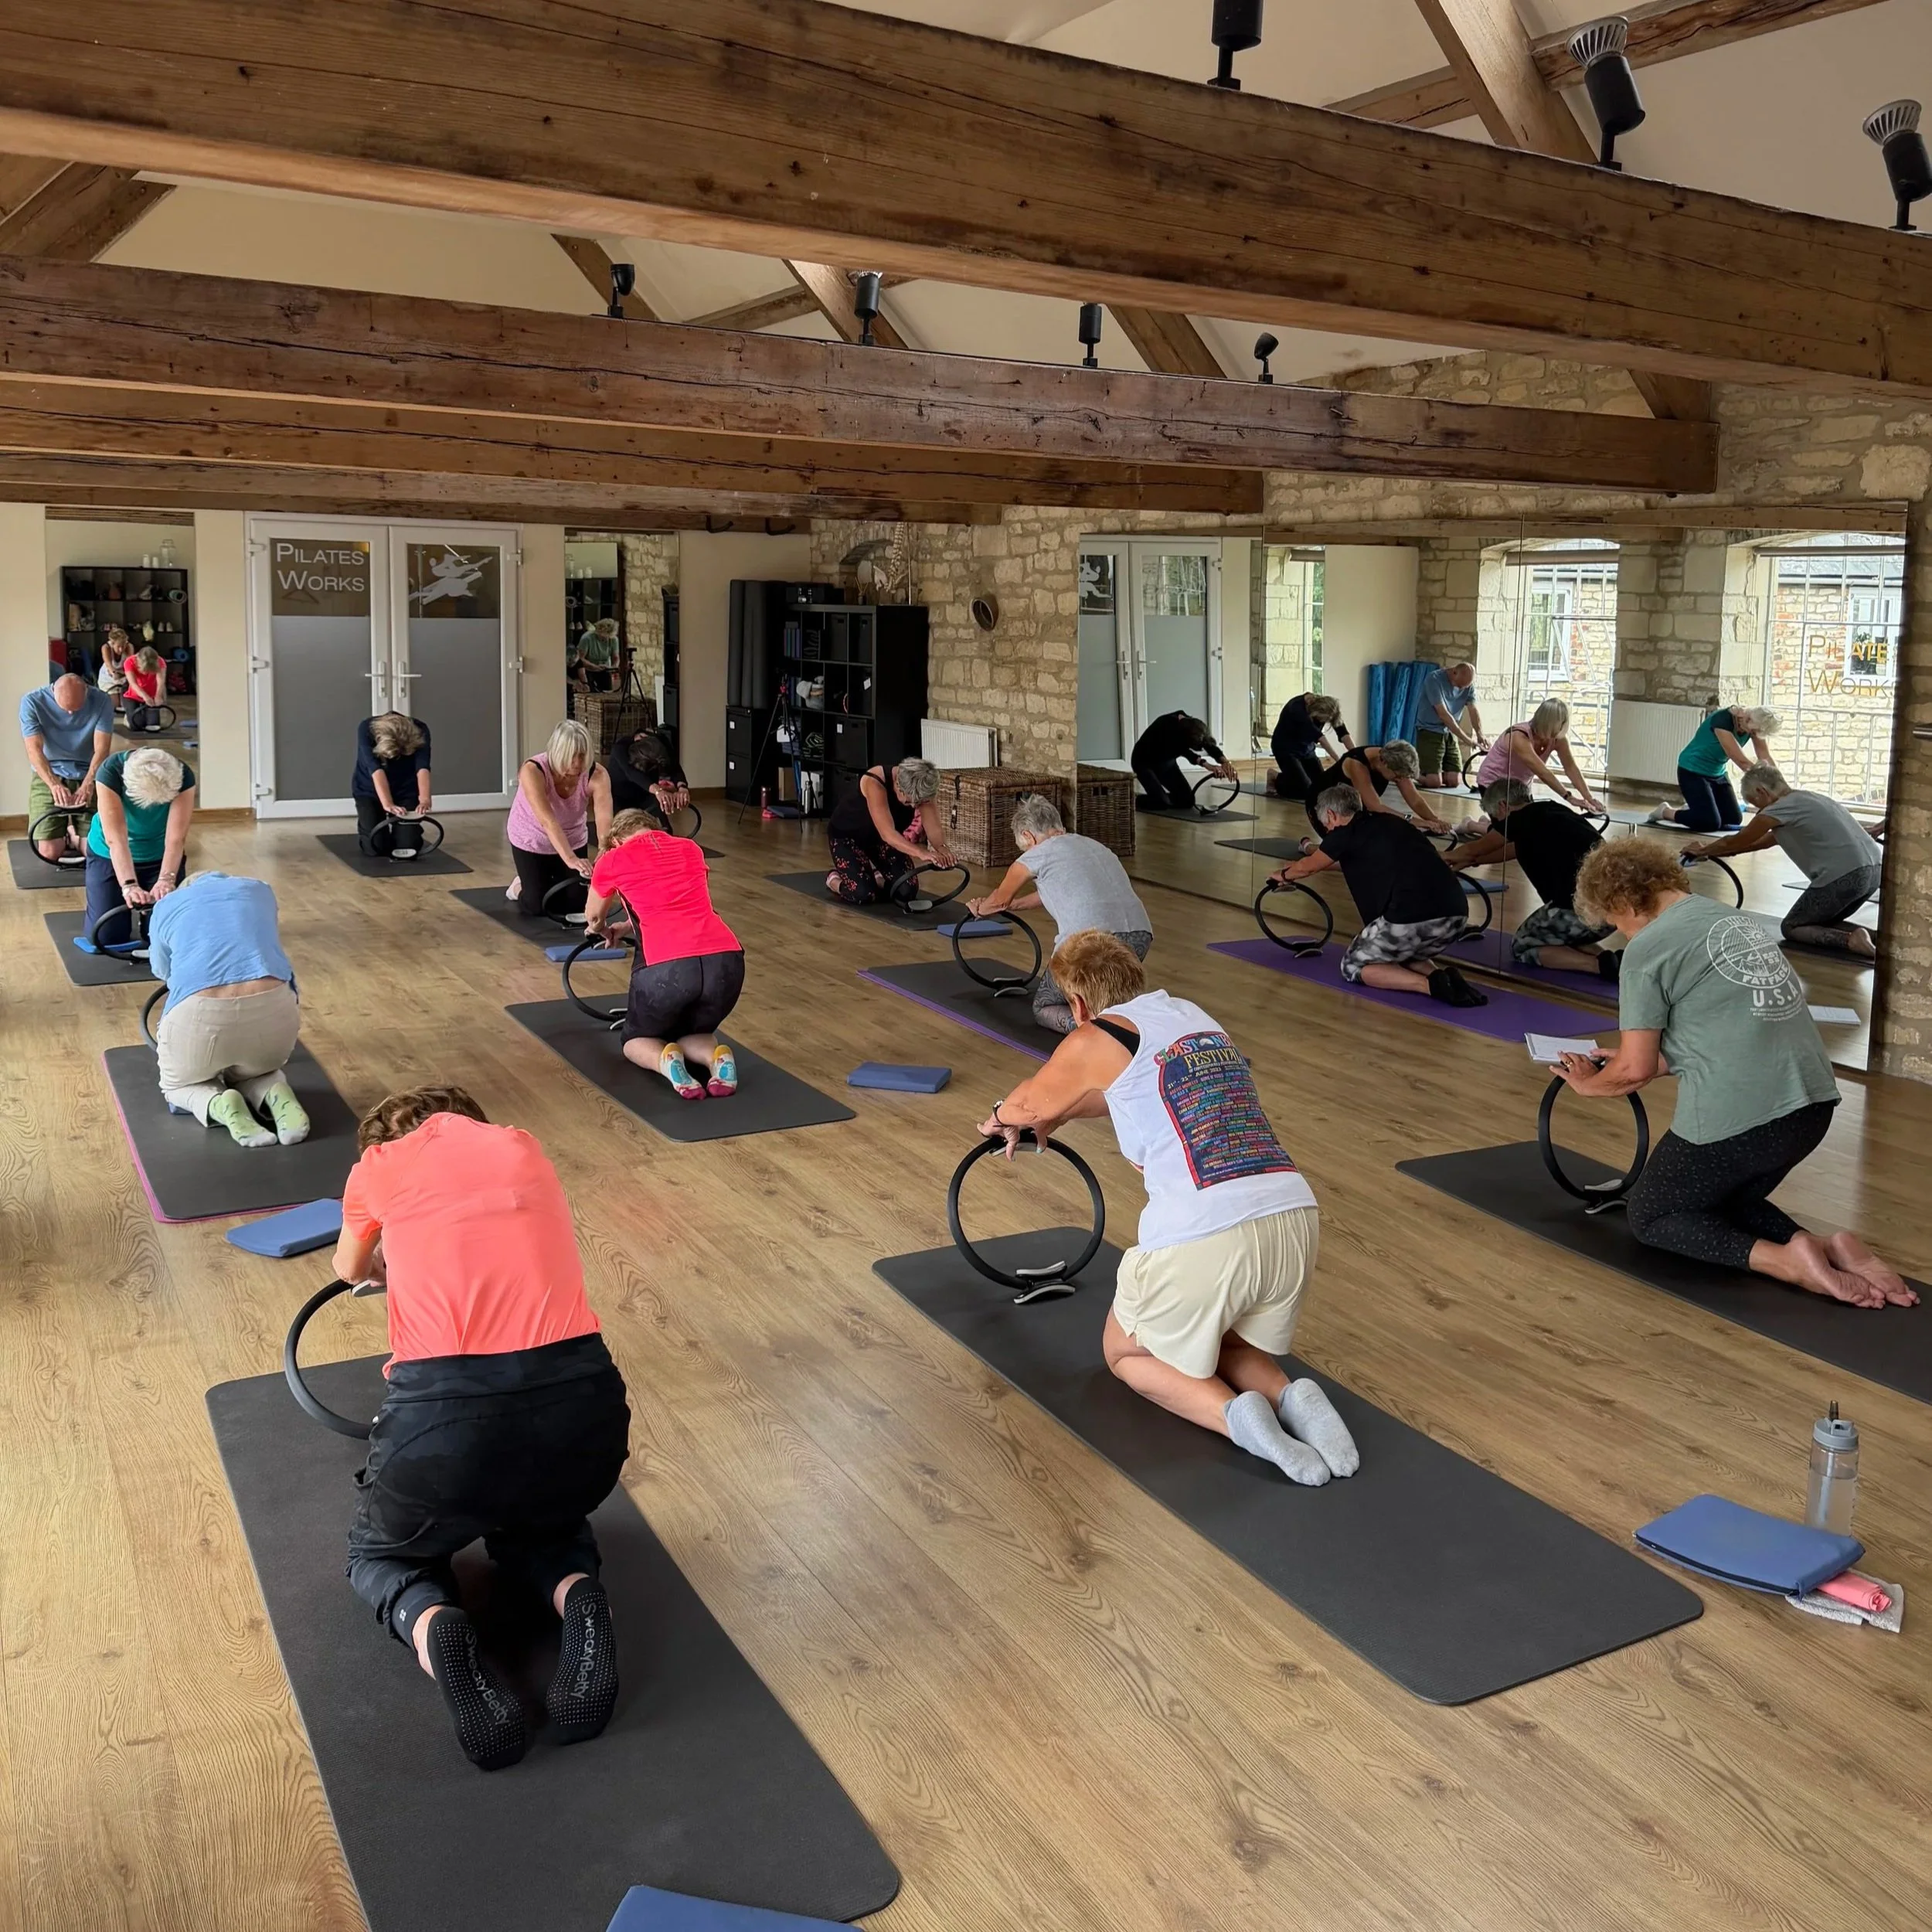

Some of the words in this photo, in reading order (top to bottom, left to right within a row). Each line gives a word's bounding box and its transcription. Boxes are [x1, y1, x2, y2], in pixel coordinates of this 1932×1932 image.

[277, 543, 364, 565] PILATES
[277, 570, 365, 591] WORKS
[1808, 634, 1891, 665] PILATE
